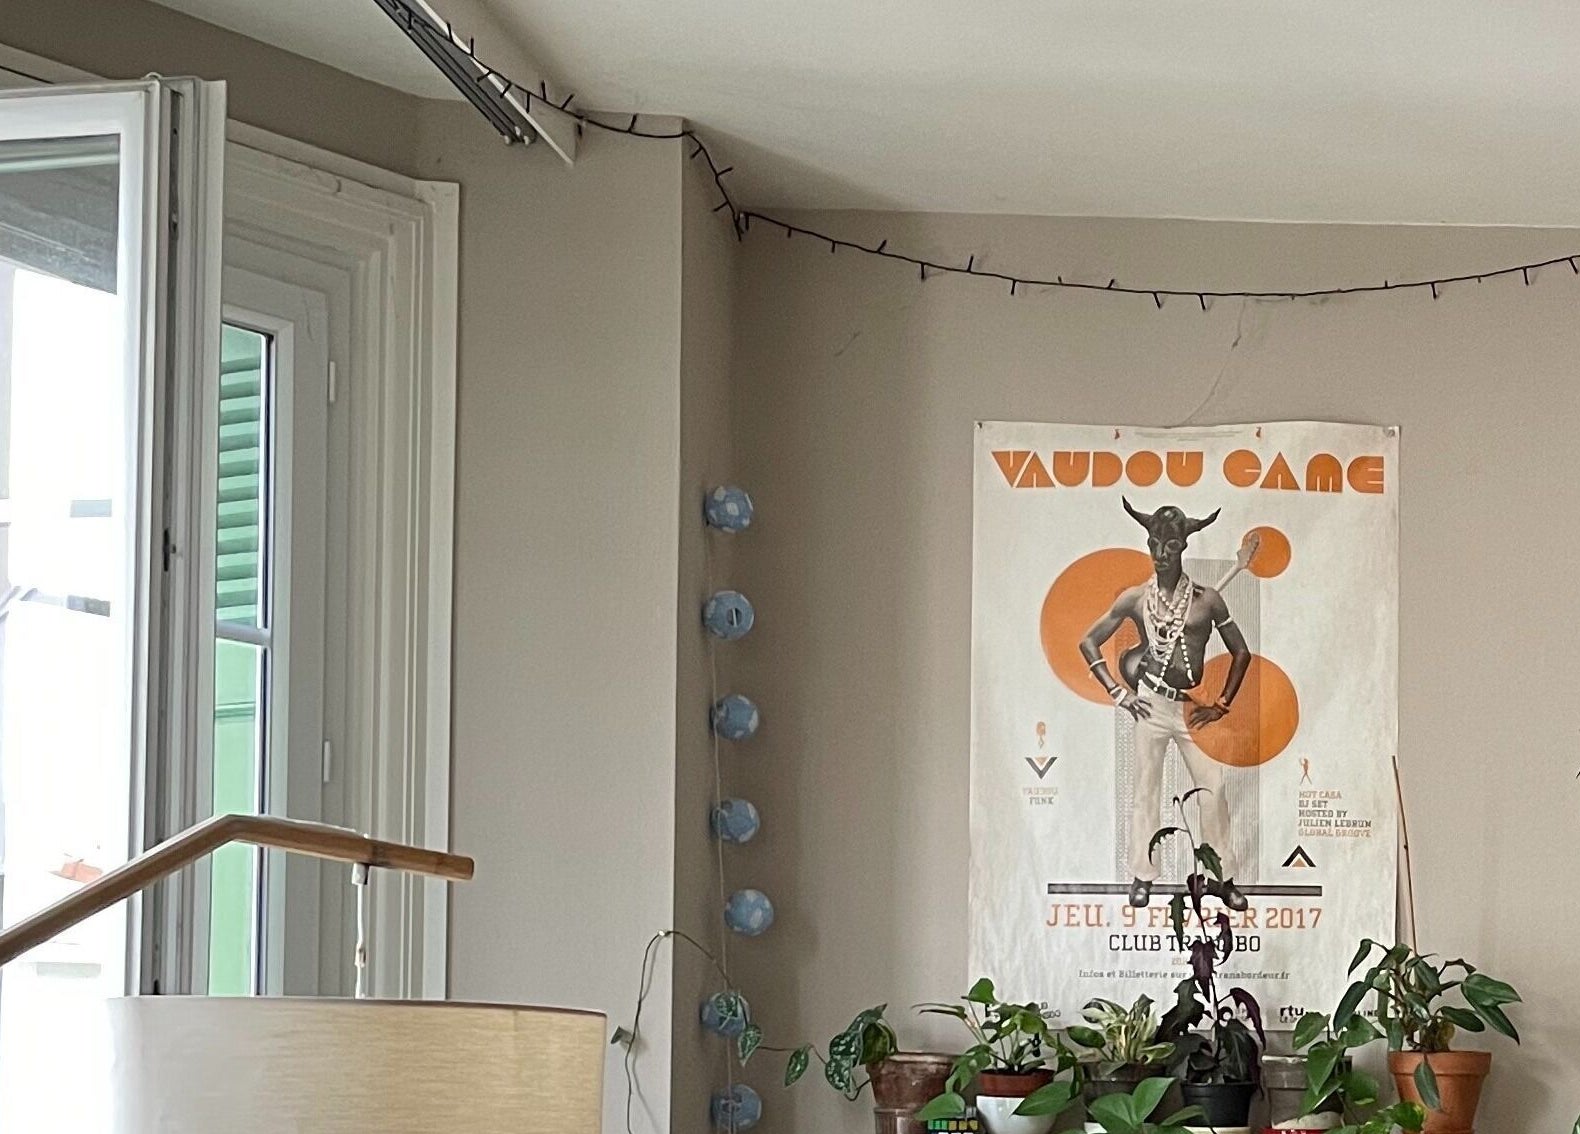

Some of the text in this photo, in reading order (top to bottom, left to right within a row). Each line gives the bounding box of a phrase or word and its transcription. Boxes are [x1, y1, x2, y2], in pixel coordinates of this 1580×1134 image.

[991, 451, 1204, 488] VAUDOU
[1312, 800, 1328, 808] SET
[1298, 809, 1348, 818] HOSTED BY
[1298, 819, 1332, 827] JULIEN
[1046, 904, 1111, 928] JEU.
[1121, 904, 1137, 928] 9
[1265, 907, 1323, 929] 2017
[1109, 934, 1162, 952] CLUB
[1079, 970, 1105, 978] Infos
[1107, 970, 1116, 978] et
[1119, 970, 1168, 979] Billetterie
